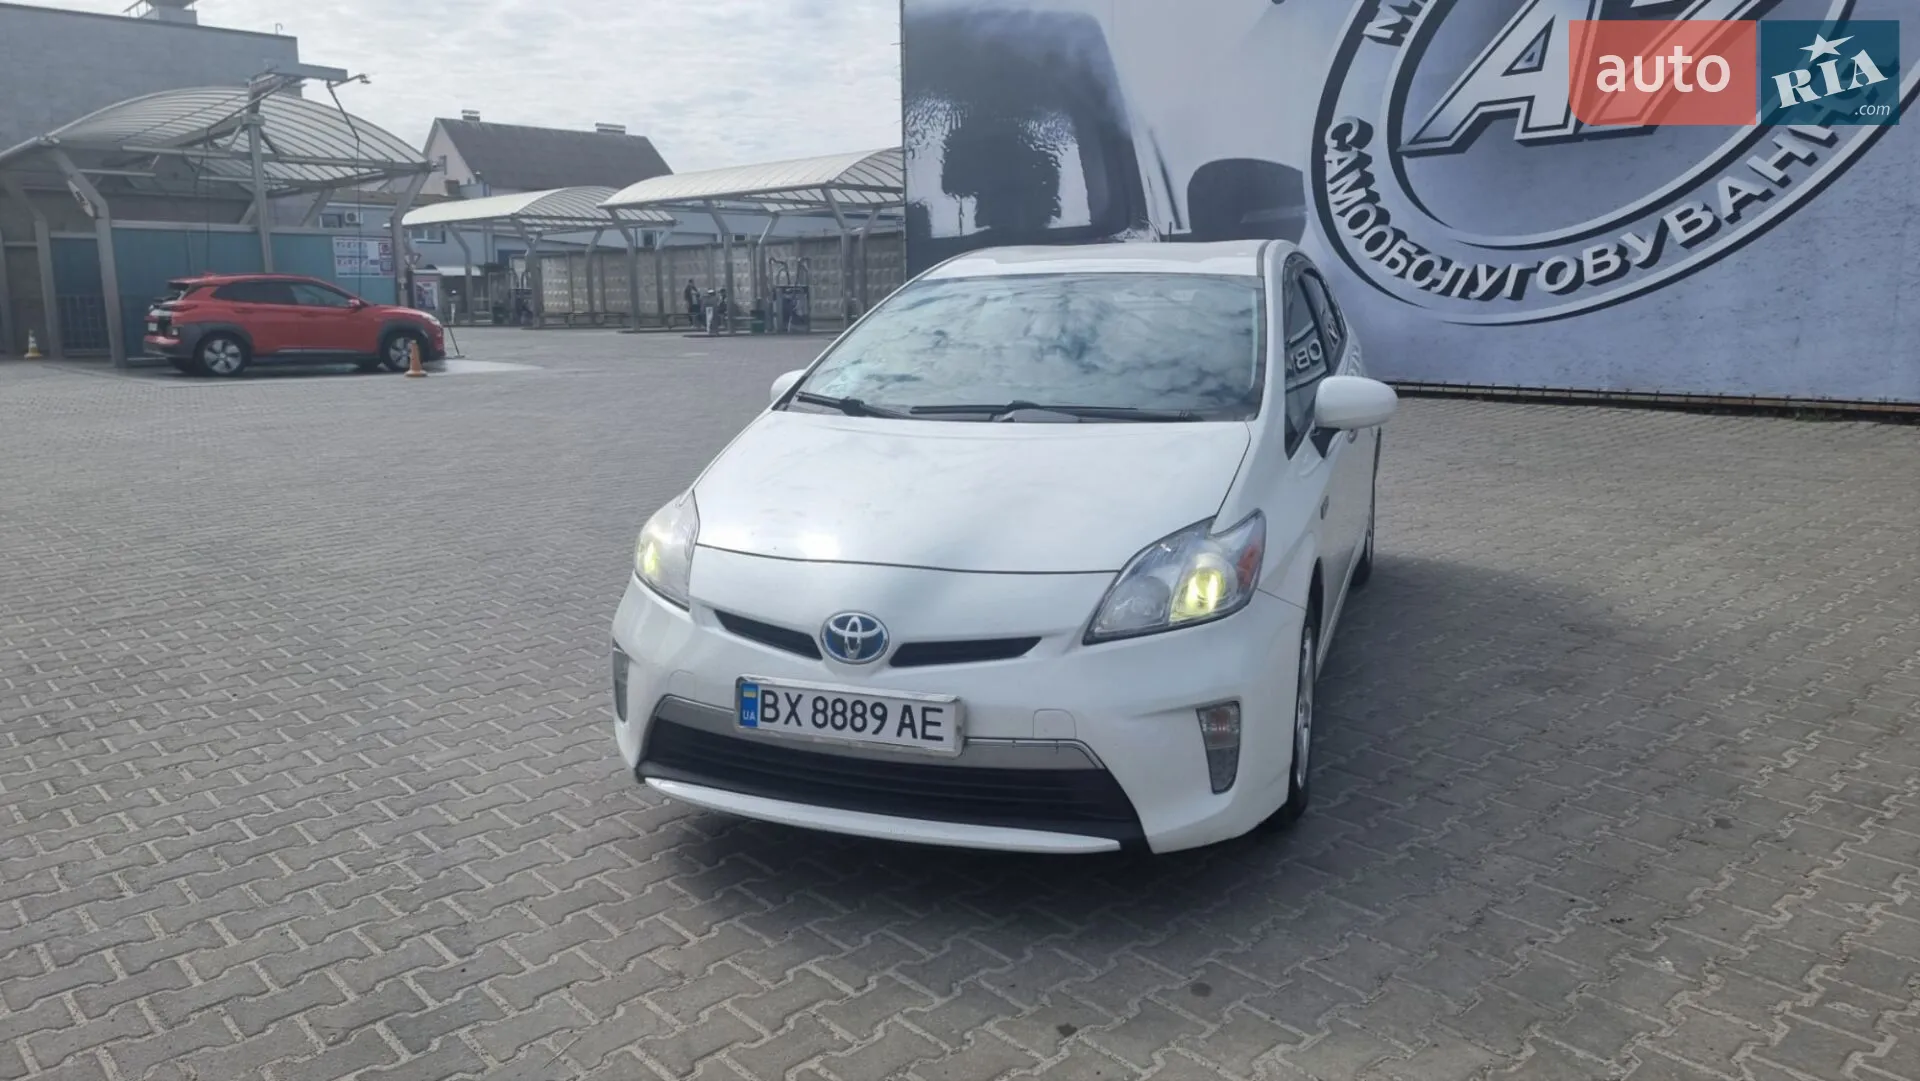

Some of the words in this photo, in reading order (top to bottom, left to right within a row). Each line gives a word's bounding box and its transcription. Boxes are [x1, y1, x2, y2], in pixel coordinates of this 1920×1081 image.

[742, 709, 756, 721] UA
[760, 689, 803, 727] BX
[811, 695, 889, 736] 8889
[896, 704, 944, 742] AE
